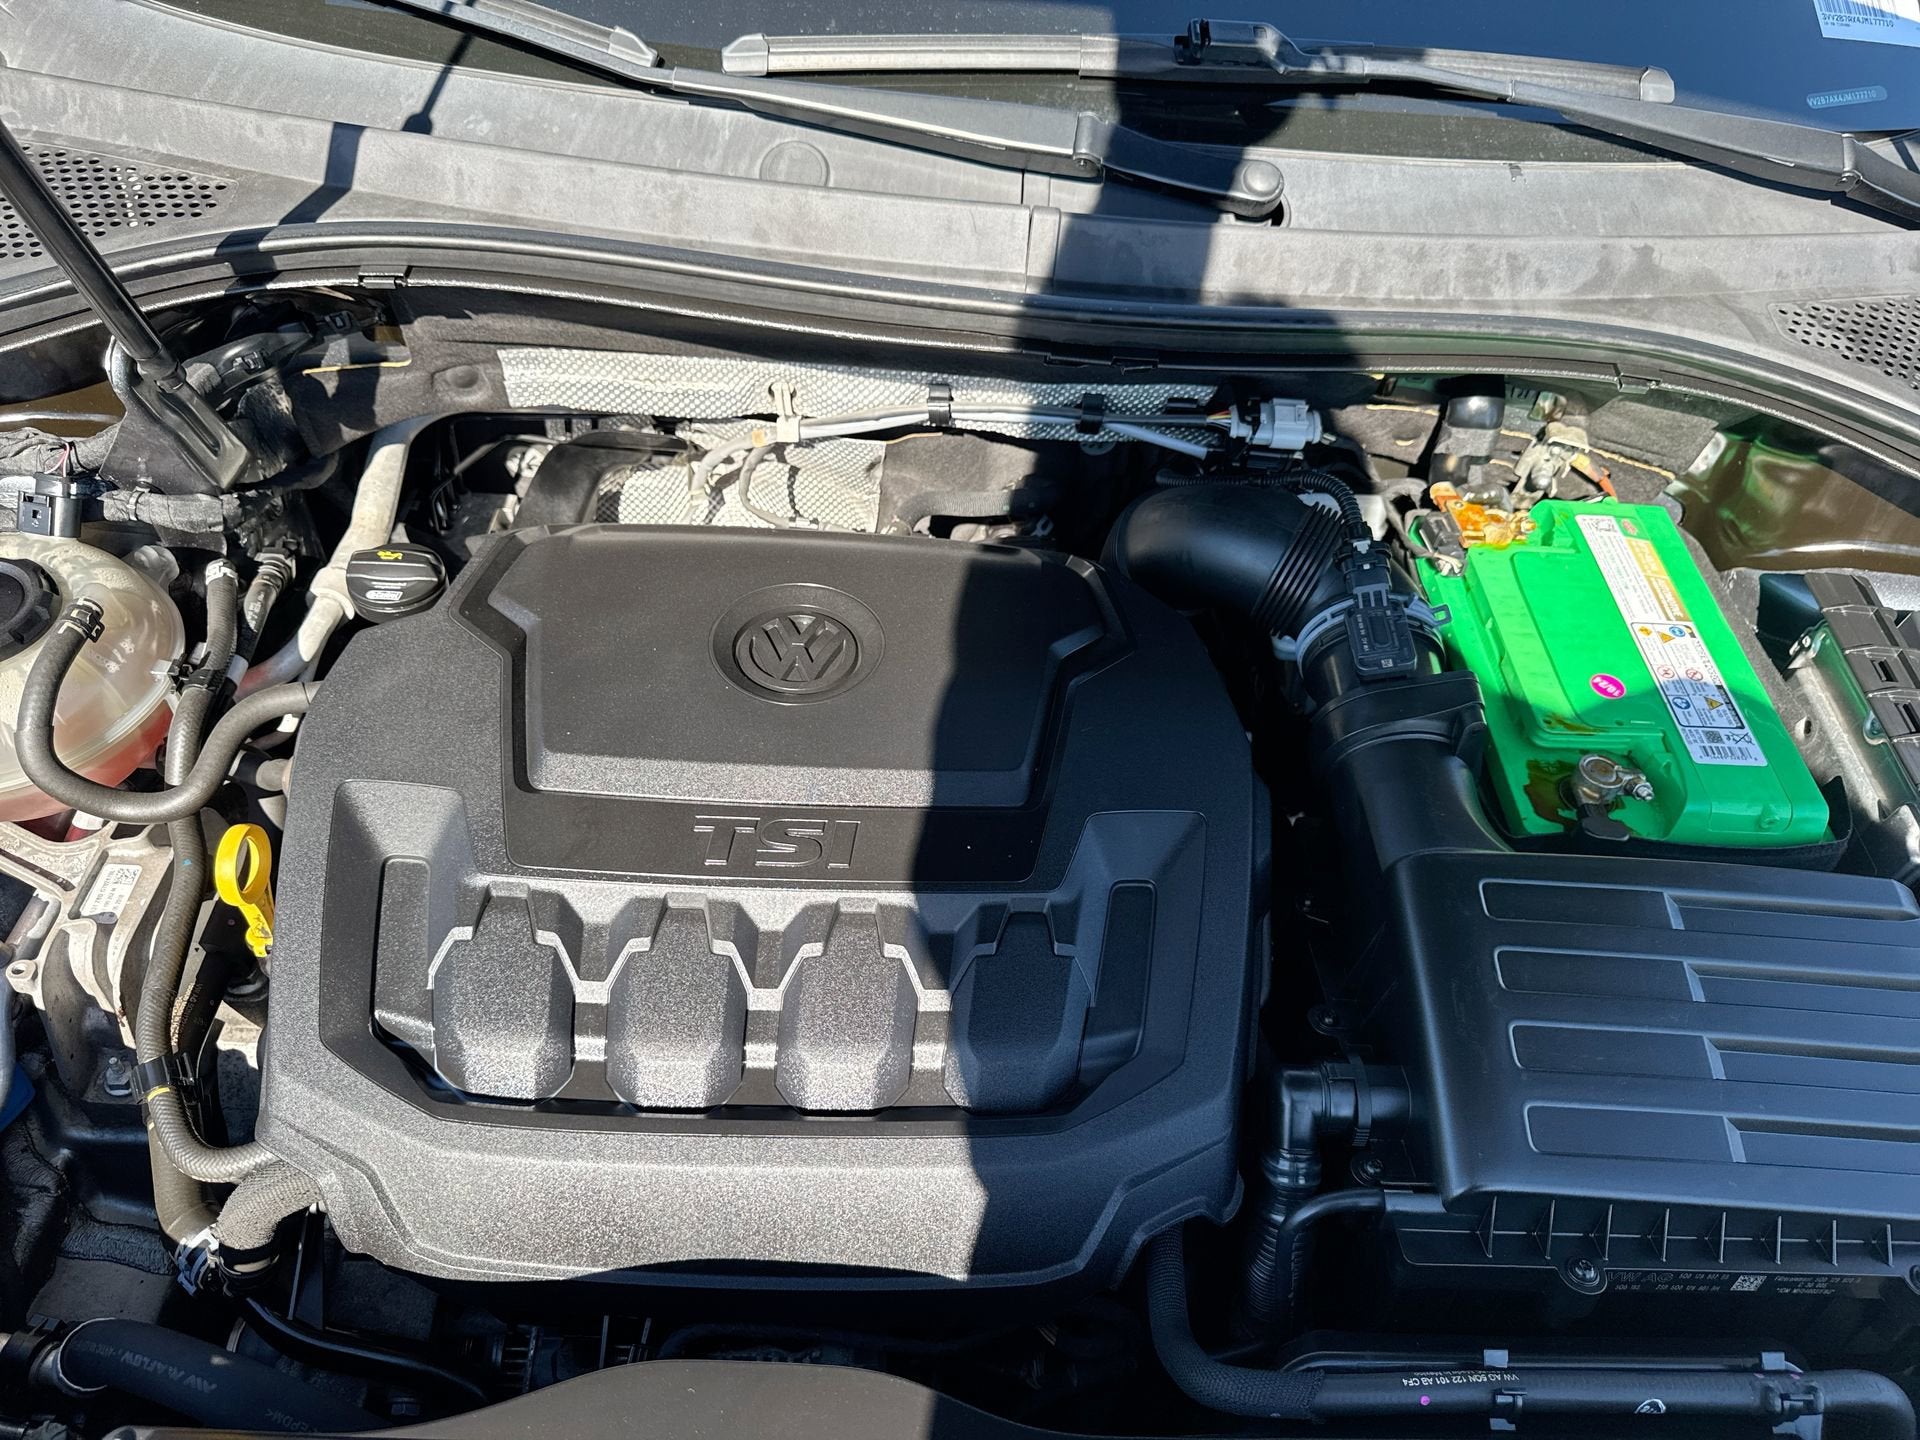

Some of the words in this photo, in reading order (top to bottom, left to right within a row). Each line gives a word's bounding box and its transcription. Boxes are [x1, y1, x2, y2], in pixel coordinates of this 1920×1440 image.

[744, 609, 851, 687] VW
[693, 814, 861, 869] TSI
[1435, 1376, 1450, 1385] 101
[1488, 1373, 1501, 1381] AG
[1503, 1373, 1520, 1381] VW
[1402, 1378, 1420, 1386] CF4
